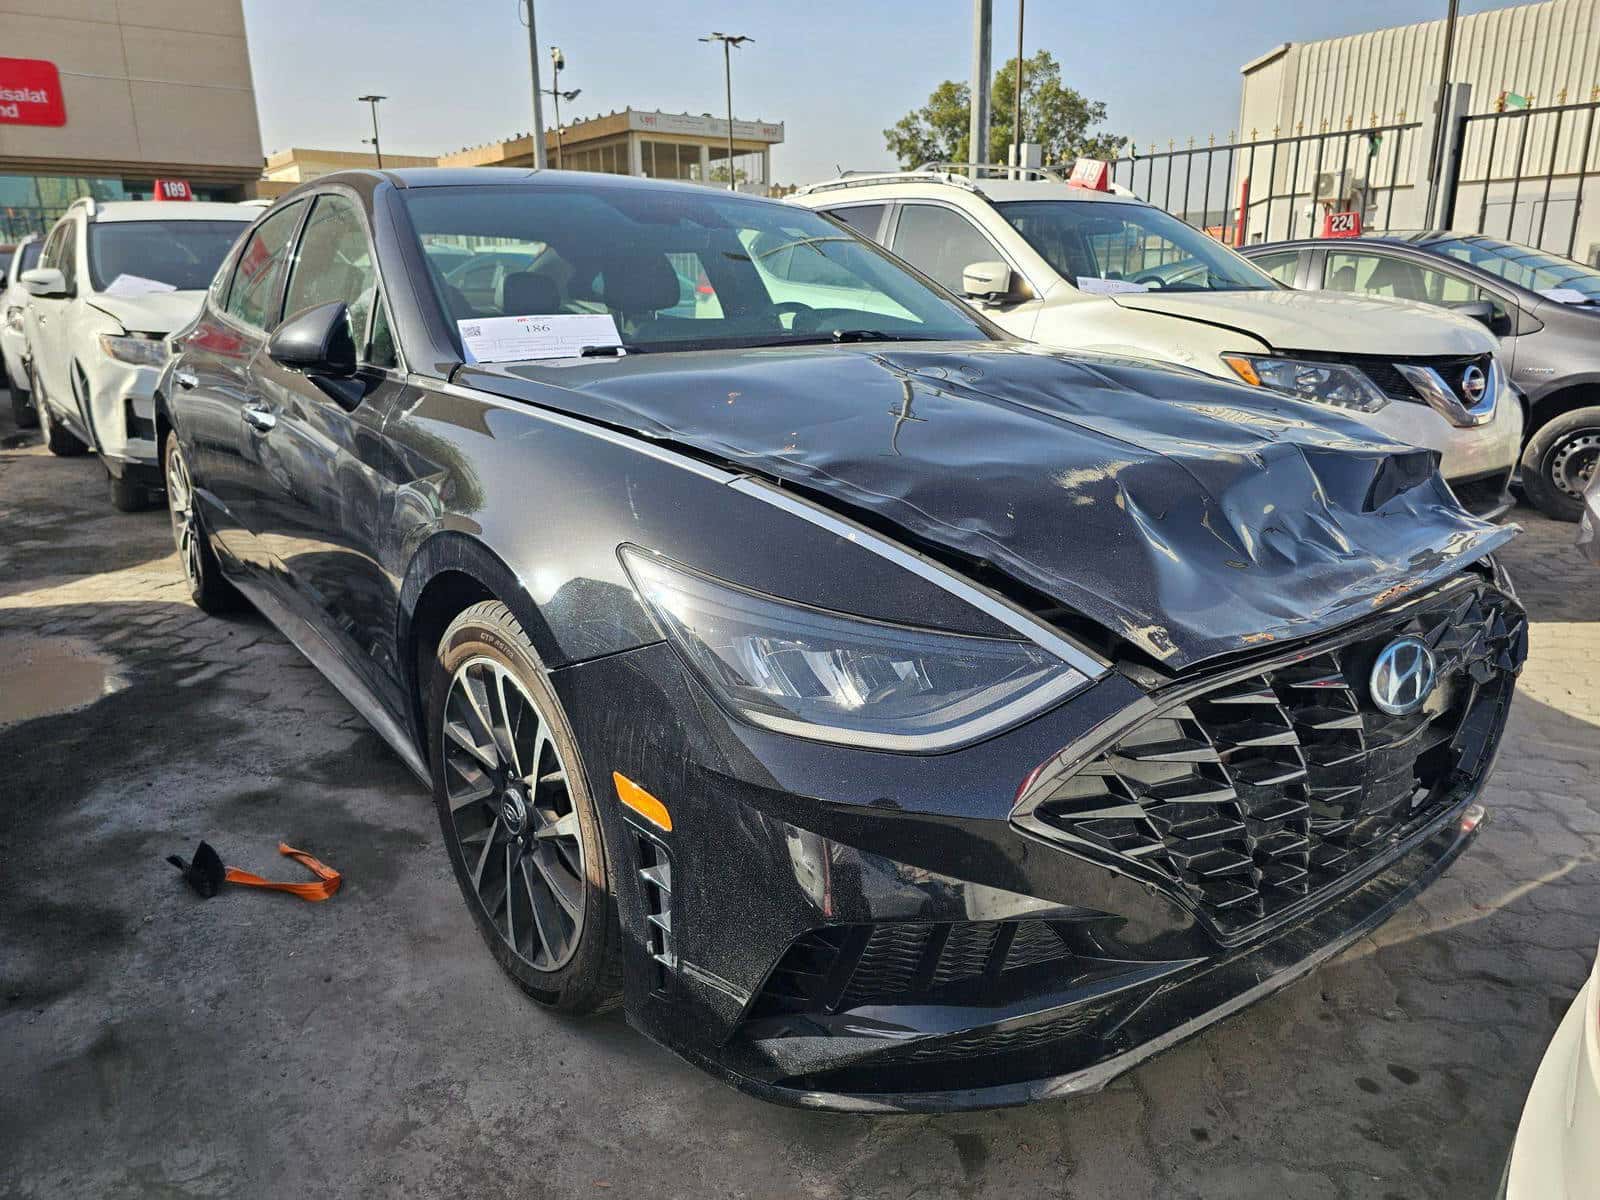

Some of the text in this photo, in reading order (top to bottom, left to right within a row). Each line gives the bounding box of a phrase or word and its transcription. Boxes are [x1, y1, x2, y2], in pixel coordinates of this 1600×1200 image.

[163, 181, 187, 198] 189
[1331, 214, 1354, 233] 224
[525, 323, 551, 333] 186
